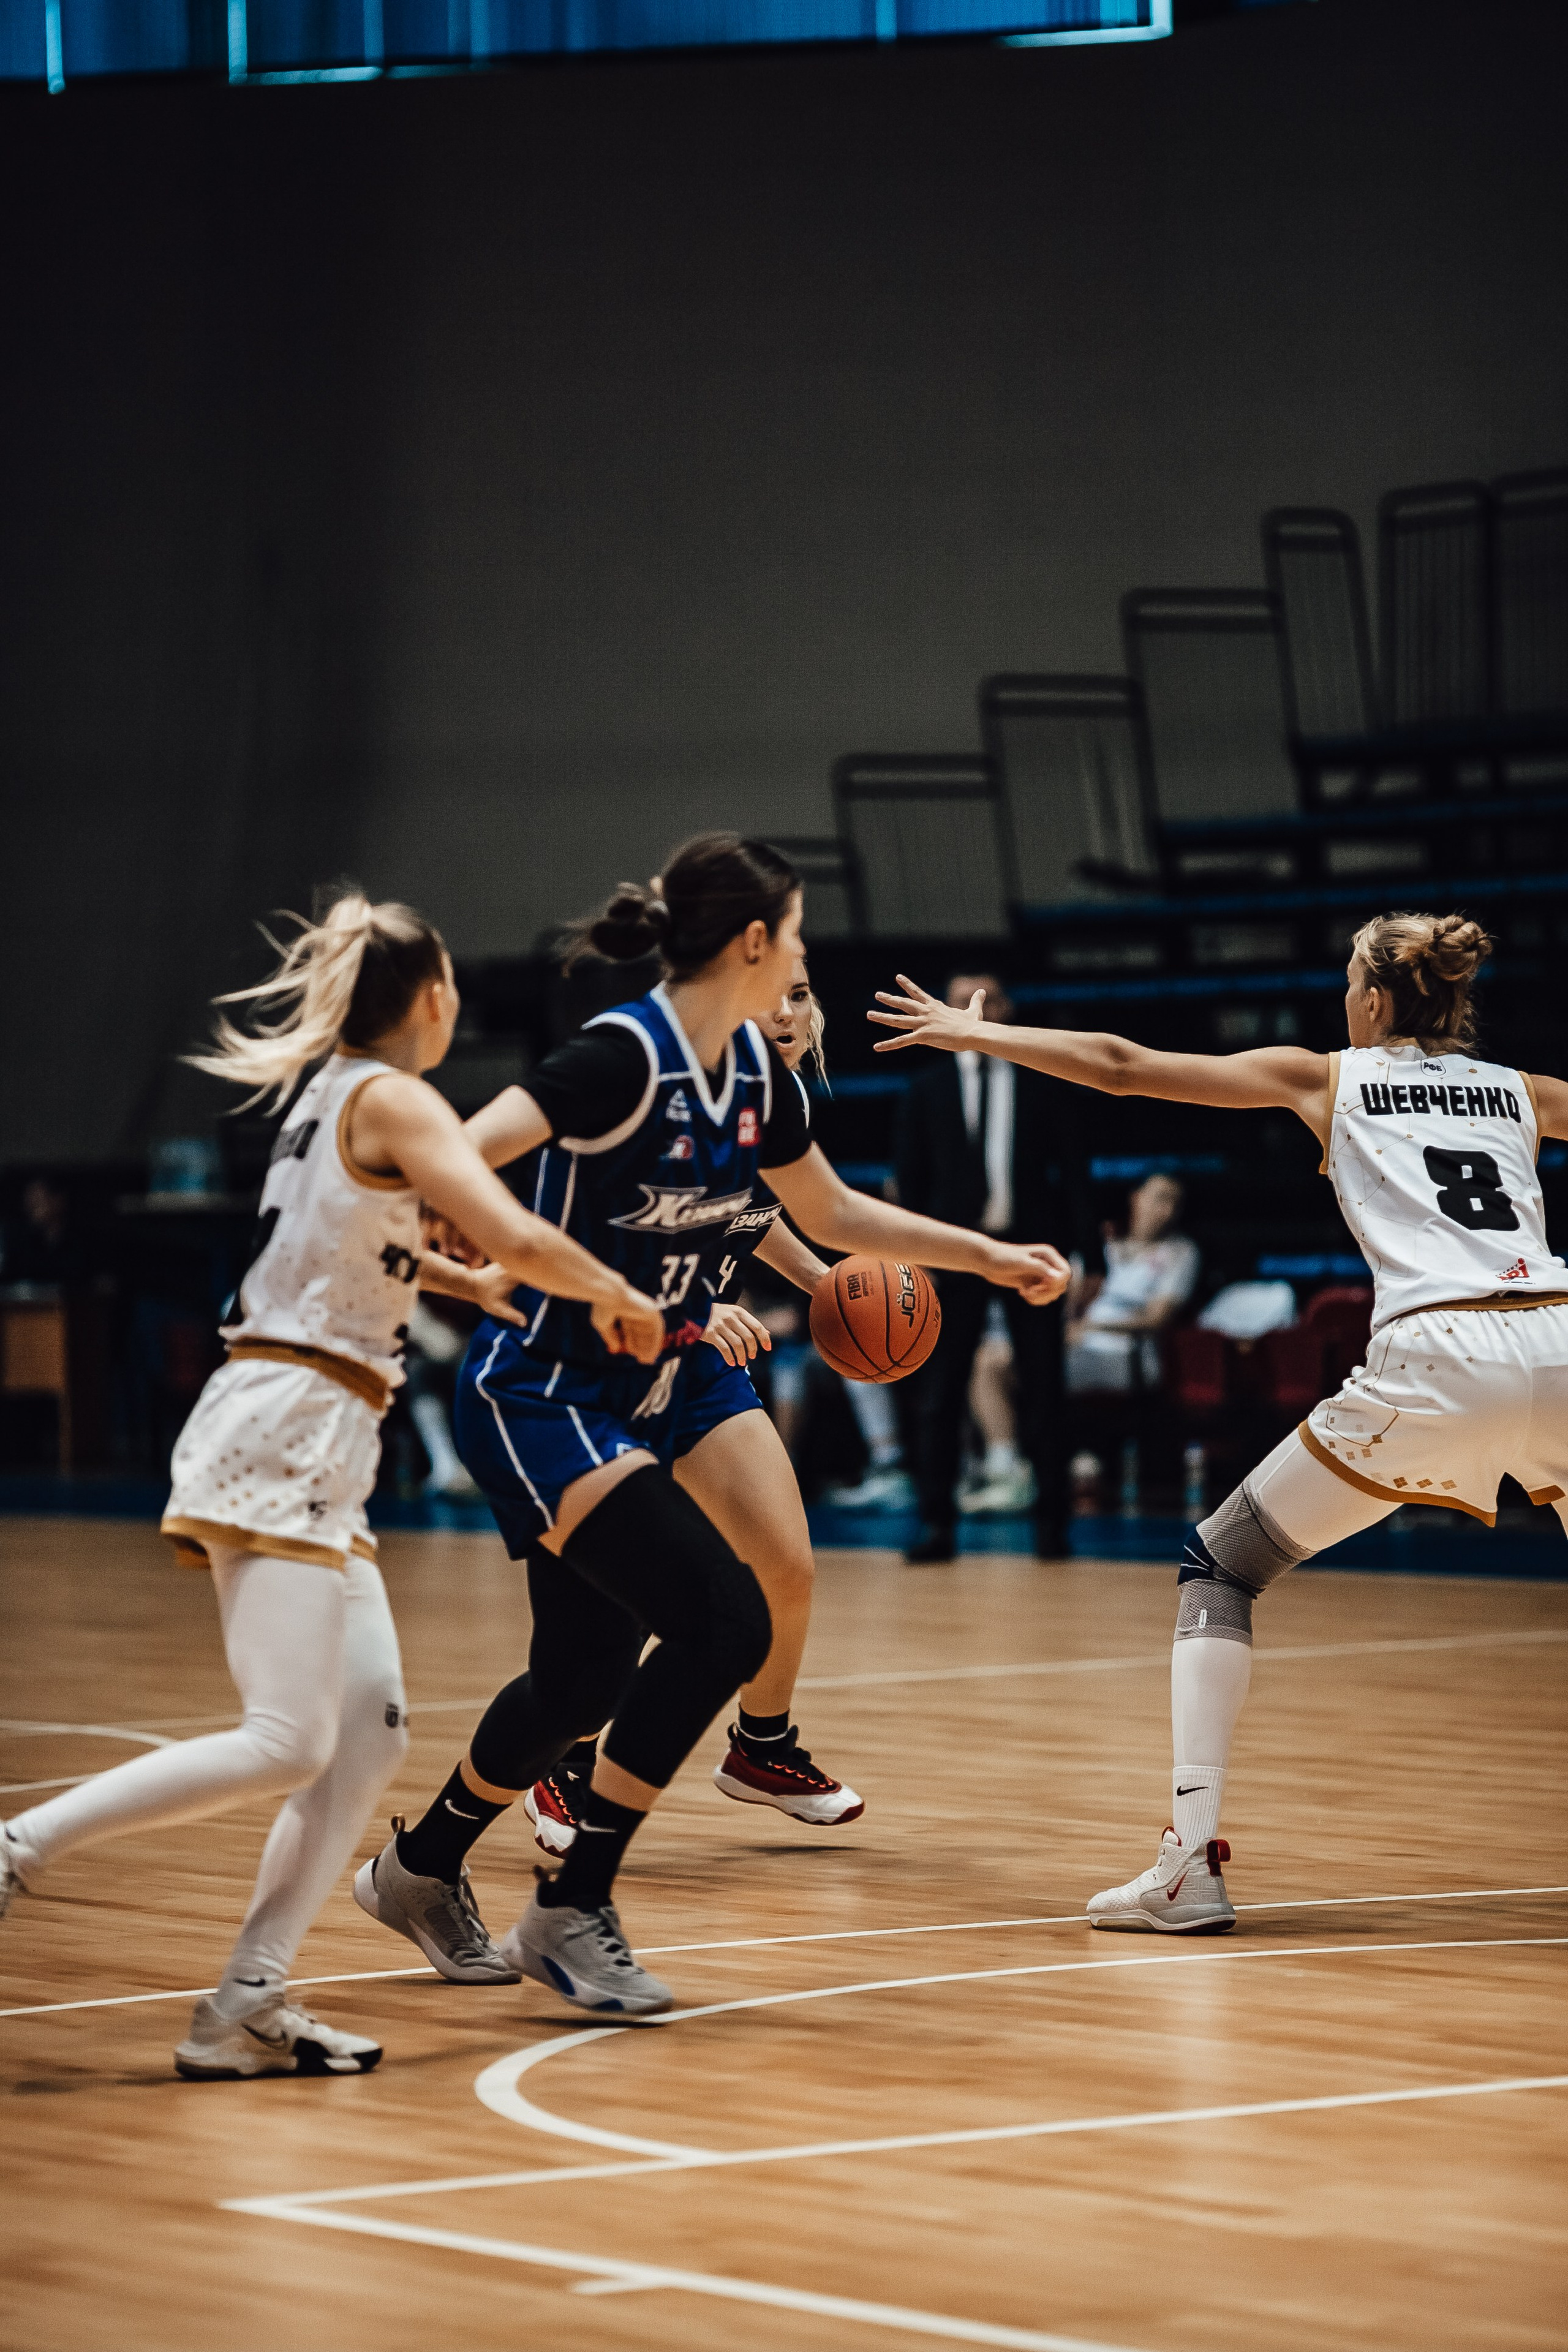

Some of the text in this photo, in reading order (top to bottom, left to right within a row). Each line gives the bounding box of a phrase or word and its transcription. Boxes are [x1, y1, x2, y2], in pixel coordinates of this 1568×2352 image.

[1423, 1061, 1442, 1071] РФБ
[1360, 1083, 1521, 1124] ШЕВЧЕНКО
[1423, 1145, 1521, 1232] 8
[846, 1273, 861, 1300] FIBA
[895, 1262, 914, 1328] JÖGE
